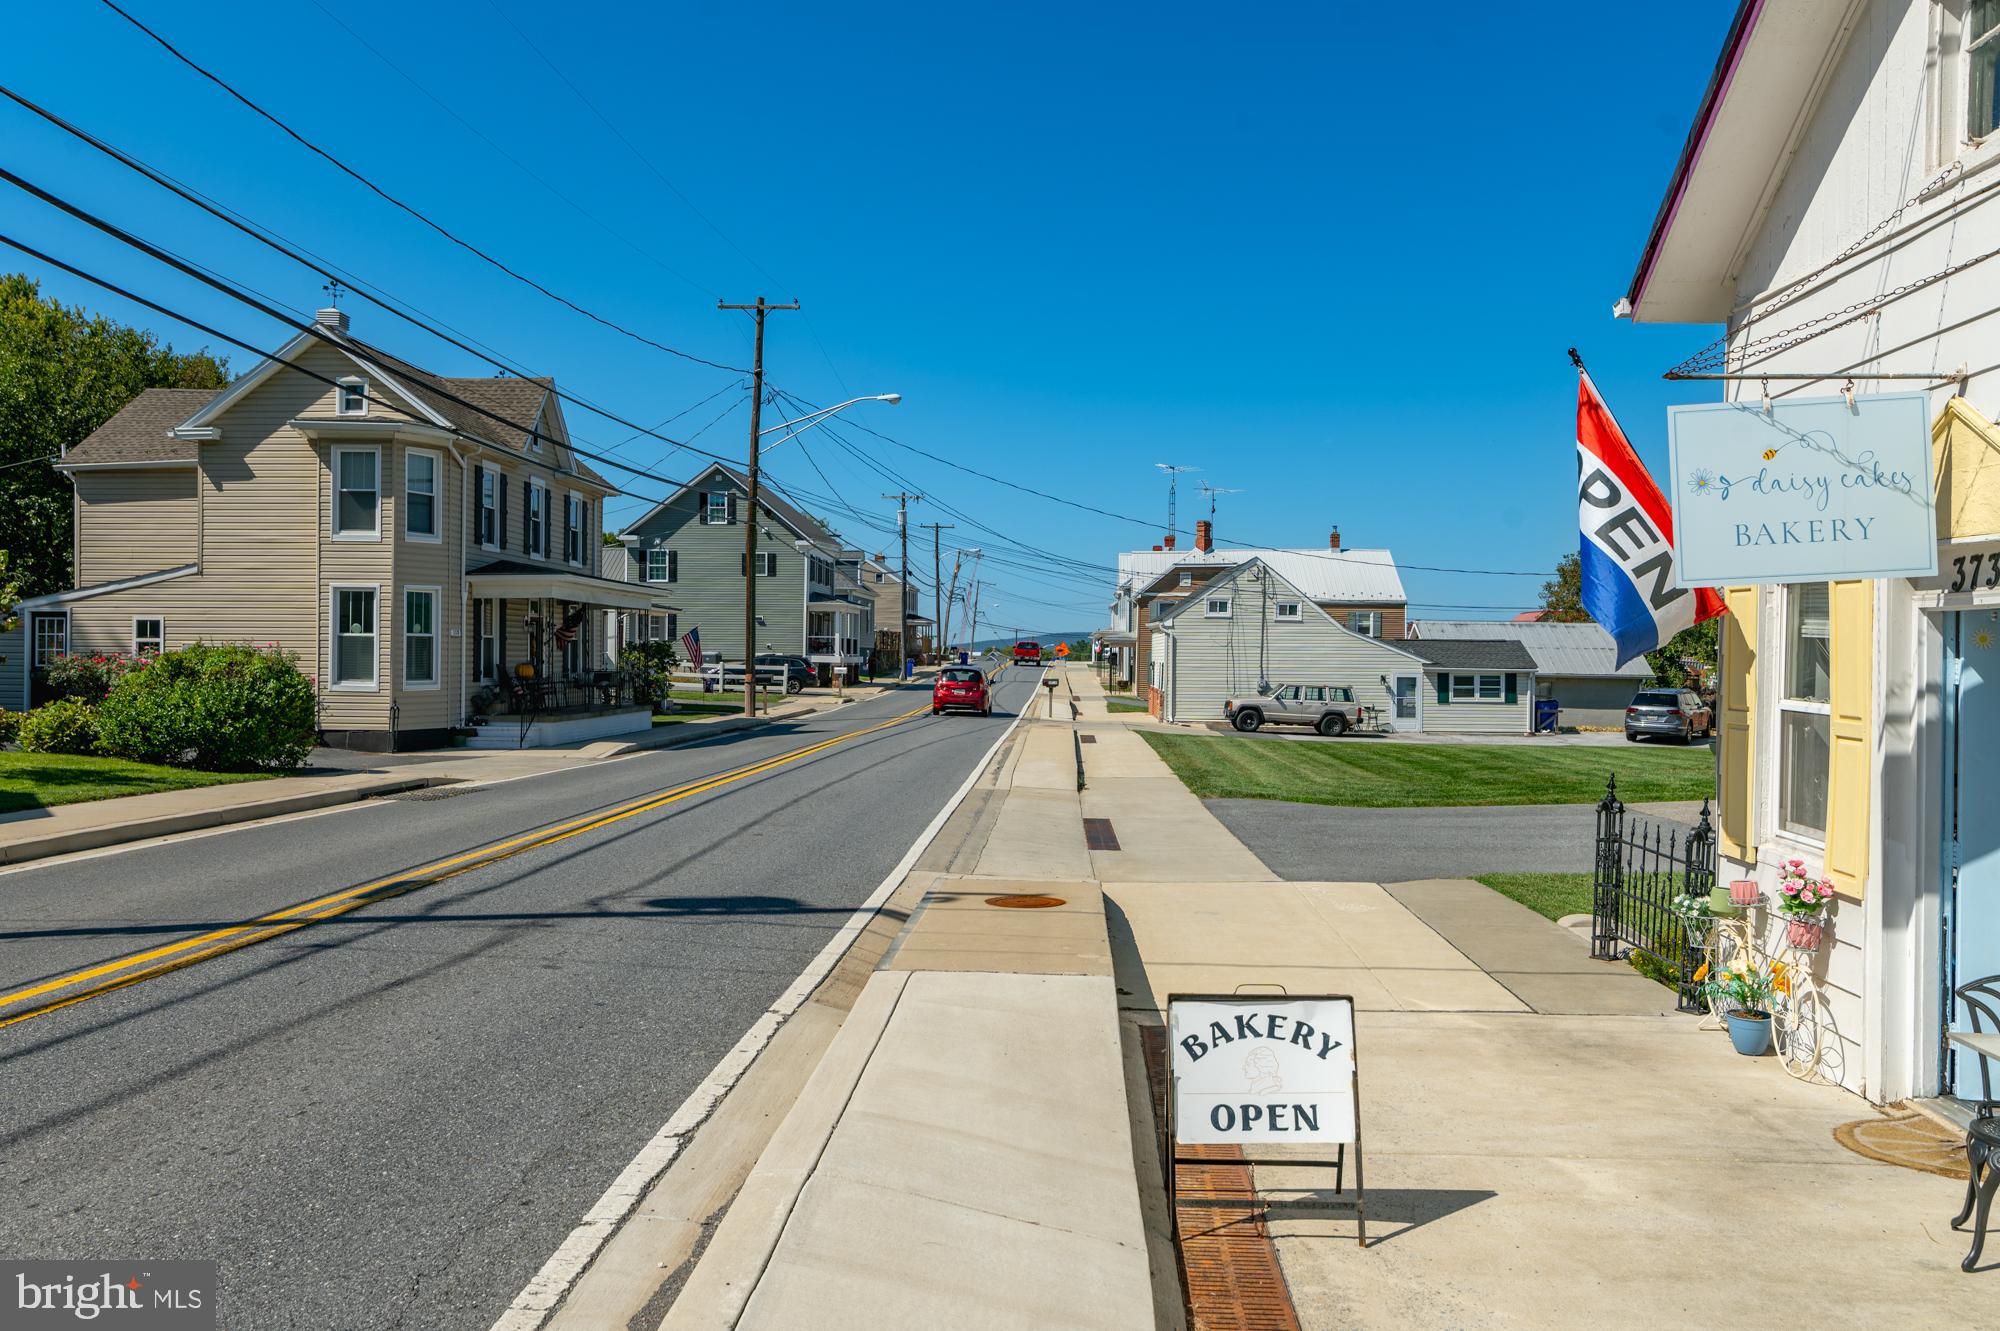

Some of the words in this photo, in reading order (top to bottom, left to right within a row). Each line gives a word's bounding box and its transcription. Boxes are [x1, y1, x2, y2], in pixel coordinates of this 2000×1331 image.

[1752, 467, 1831, 511] daisy
[1840, 461, 1914, 494] cakes
[1734, 517, 1875, 547] BAKERY
[1951, 552, 2000, 592] 373
[1179, 1012, 1343, 1062] BAKERY
[1210, 1103, 1321, 1132] OPEN
